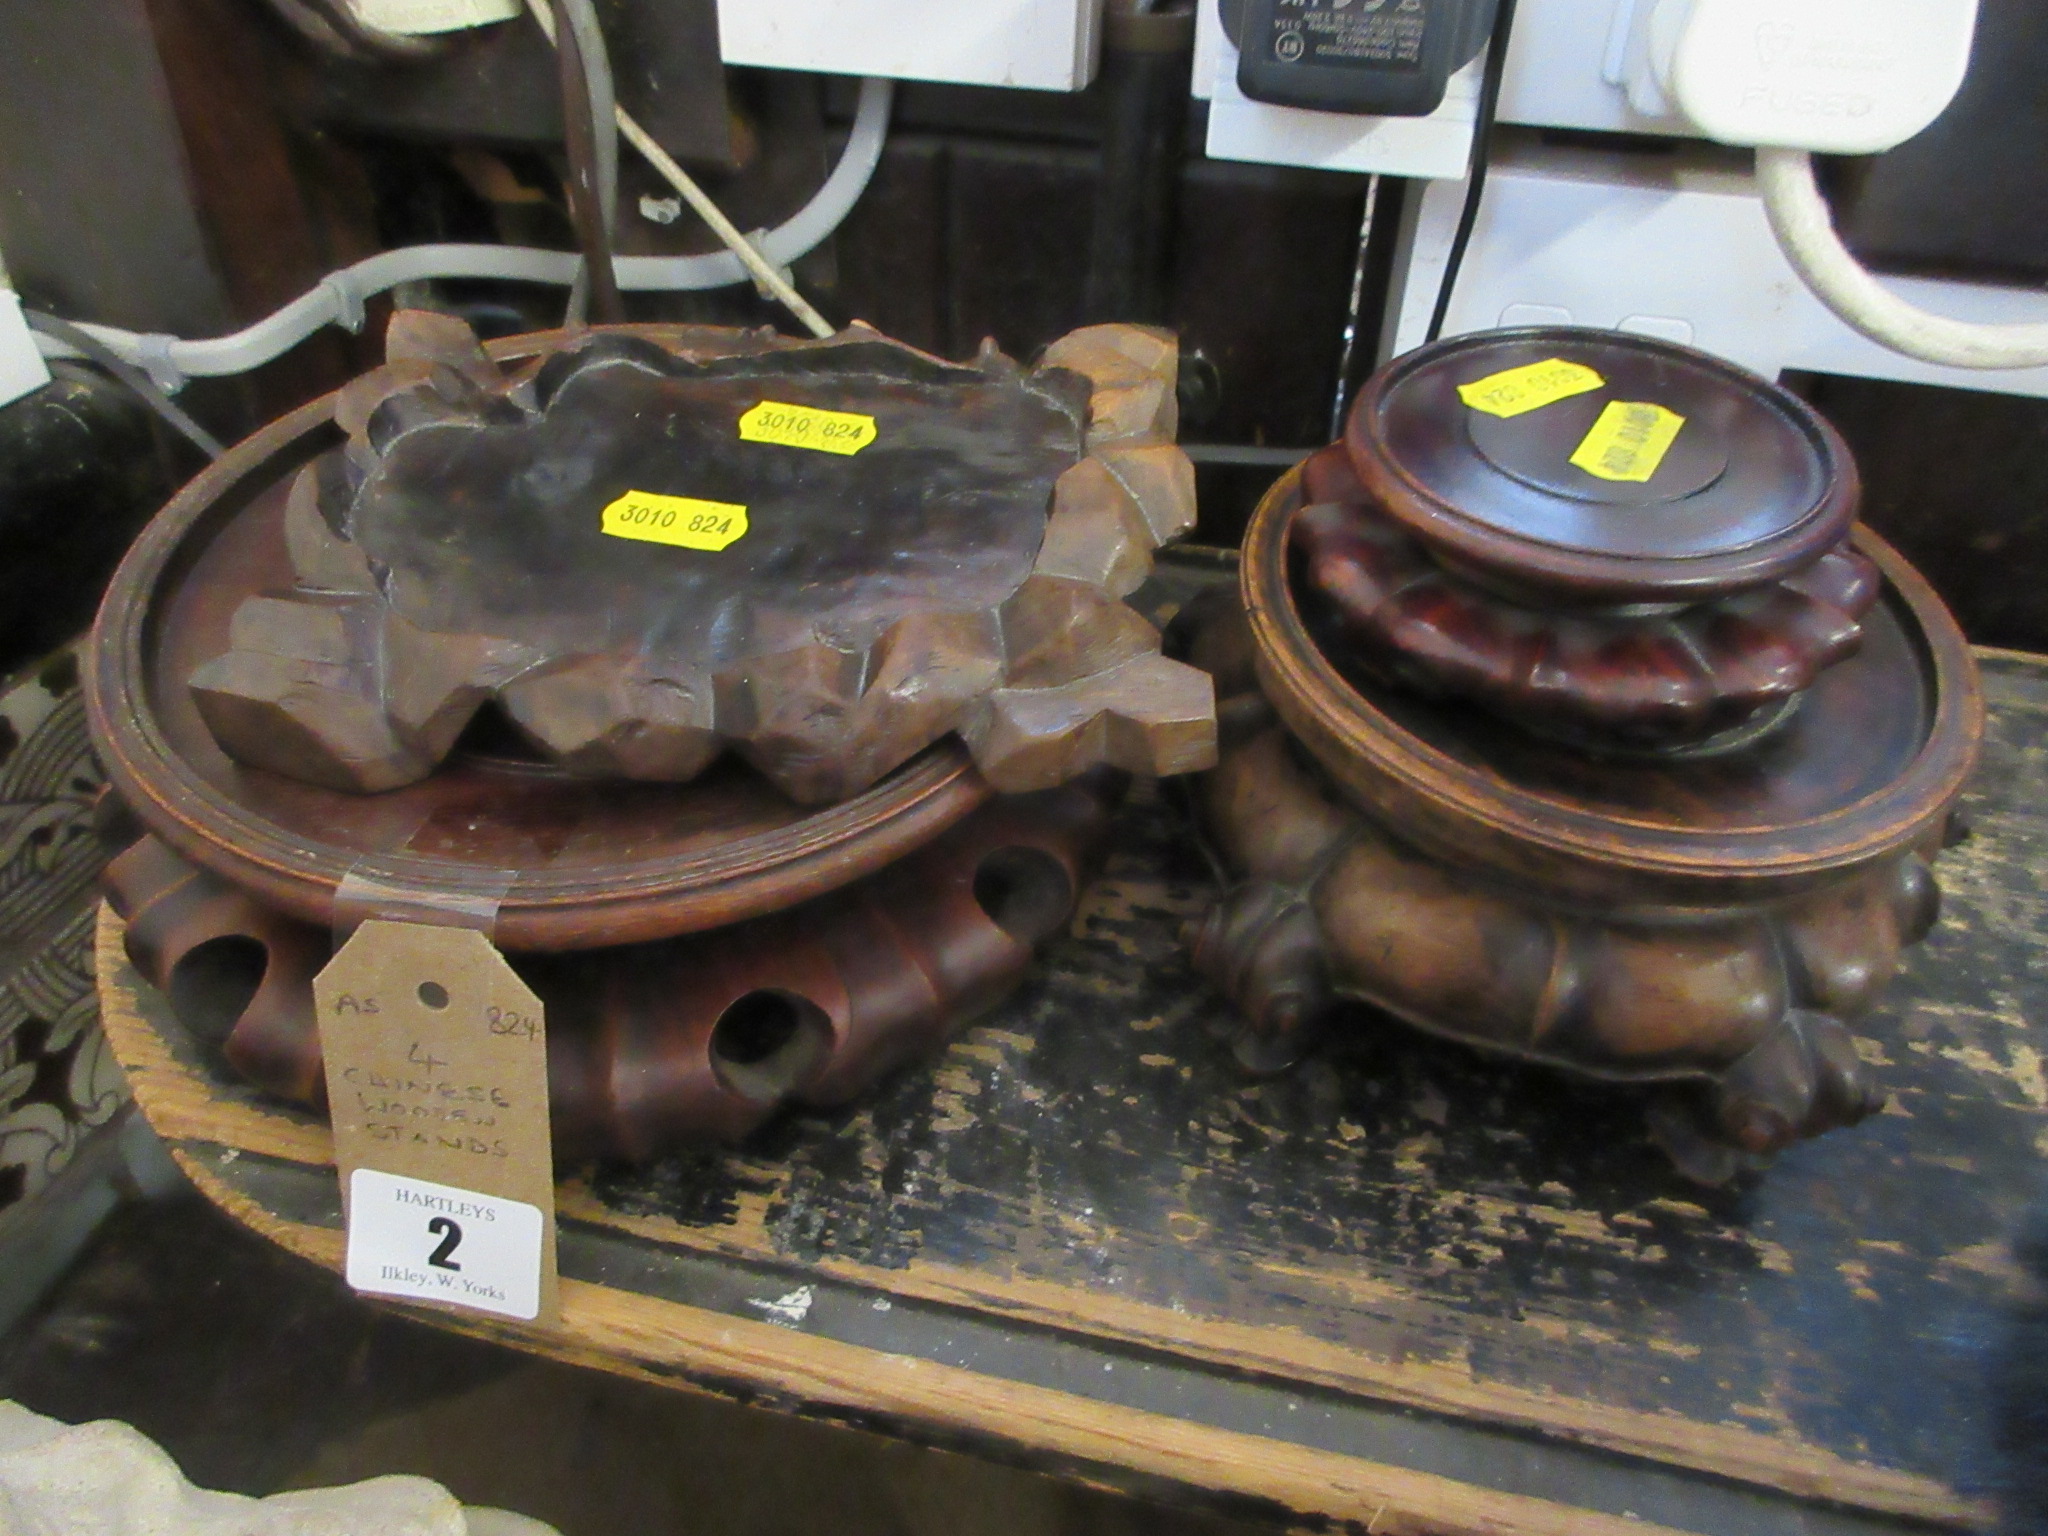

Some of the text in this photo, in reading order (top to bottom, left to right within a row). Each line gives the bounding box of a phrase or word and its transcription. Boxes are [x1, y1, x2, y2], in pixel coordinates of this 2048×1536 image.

[757, 411, 864, 441] 3010 824
[620, 504, 733, 536] 3010 824
[335, 993, 381, 1015] AS
[486, 1005, 543, 1041] 824
[407, 1042, 449, 1074] 4
[366, 1122, 509, 1157] STANDS
[395, 1188, 496, 1222] HARTLEYS
[427, 1216, 463, 1271] 2
[437, 1273, 459, 1291] W.
[463, 1278, 506, 1301] Yorks
